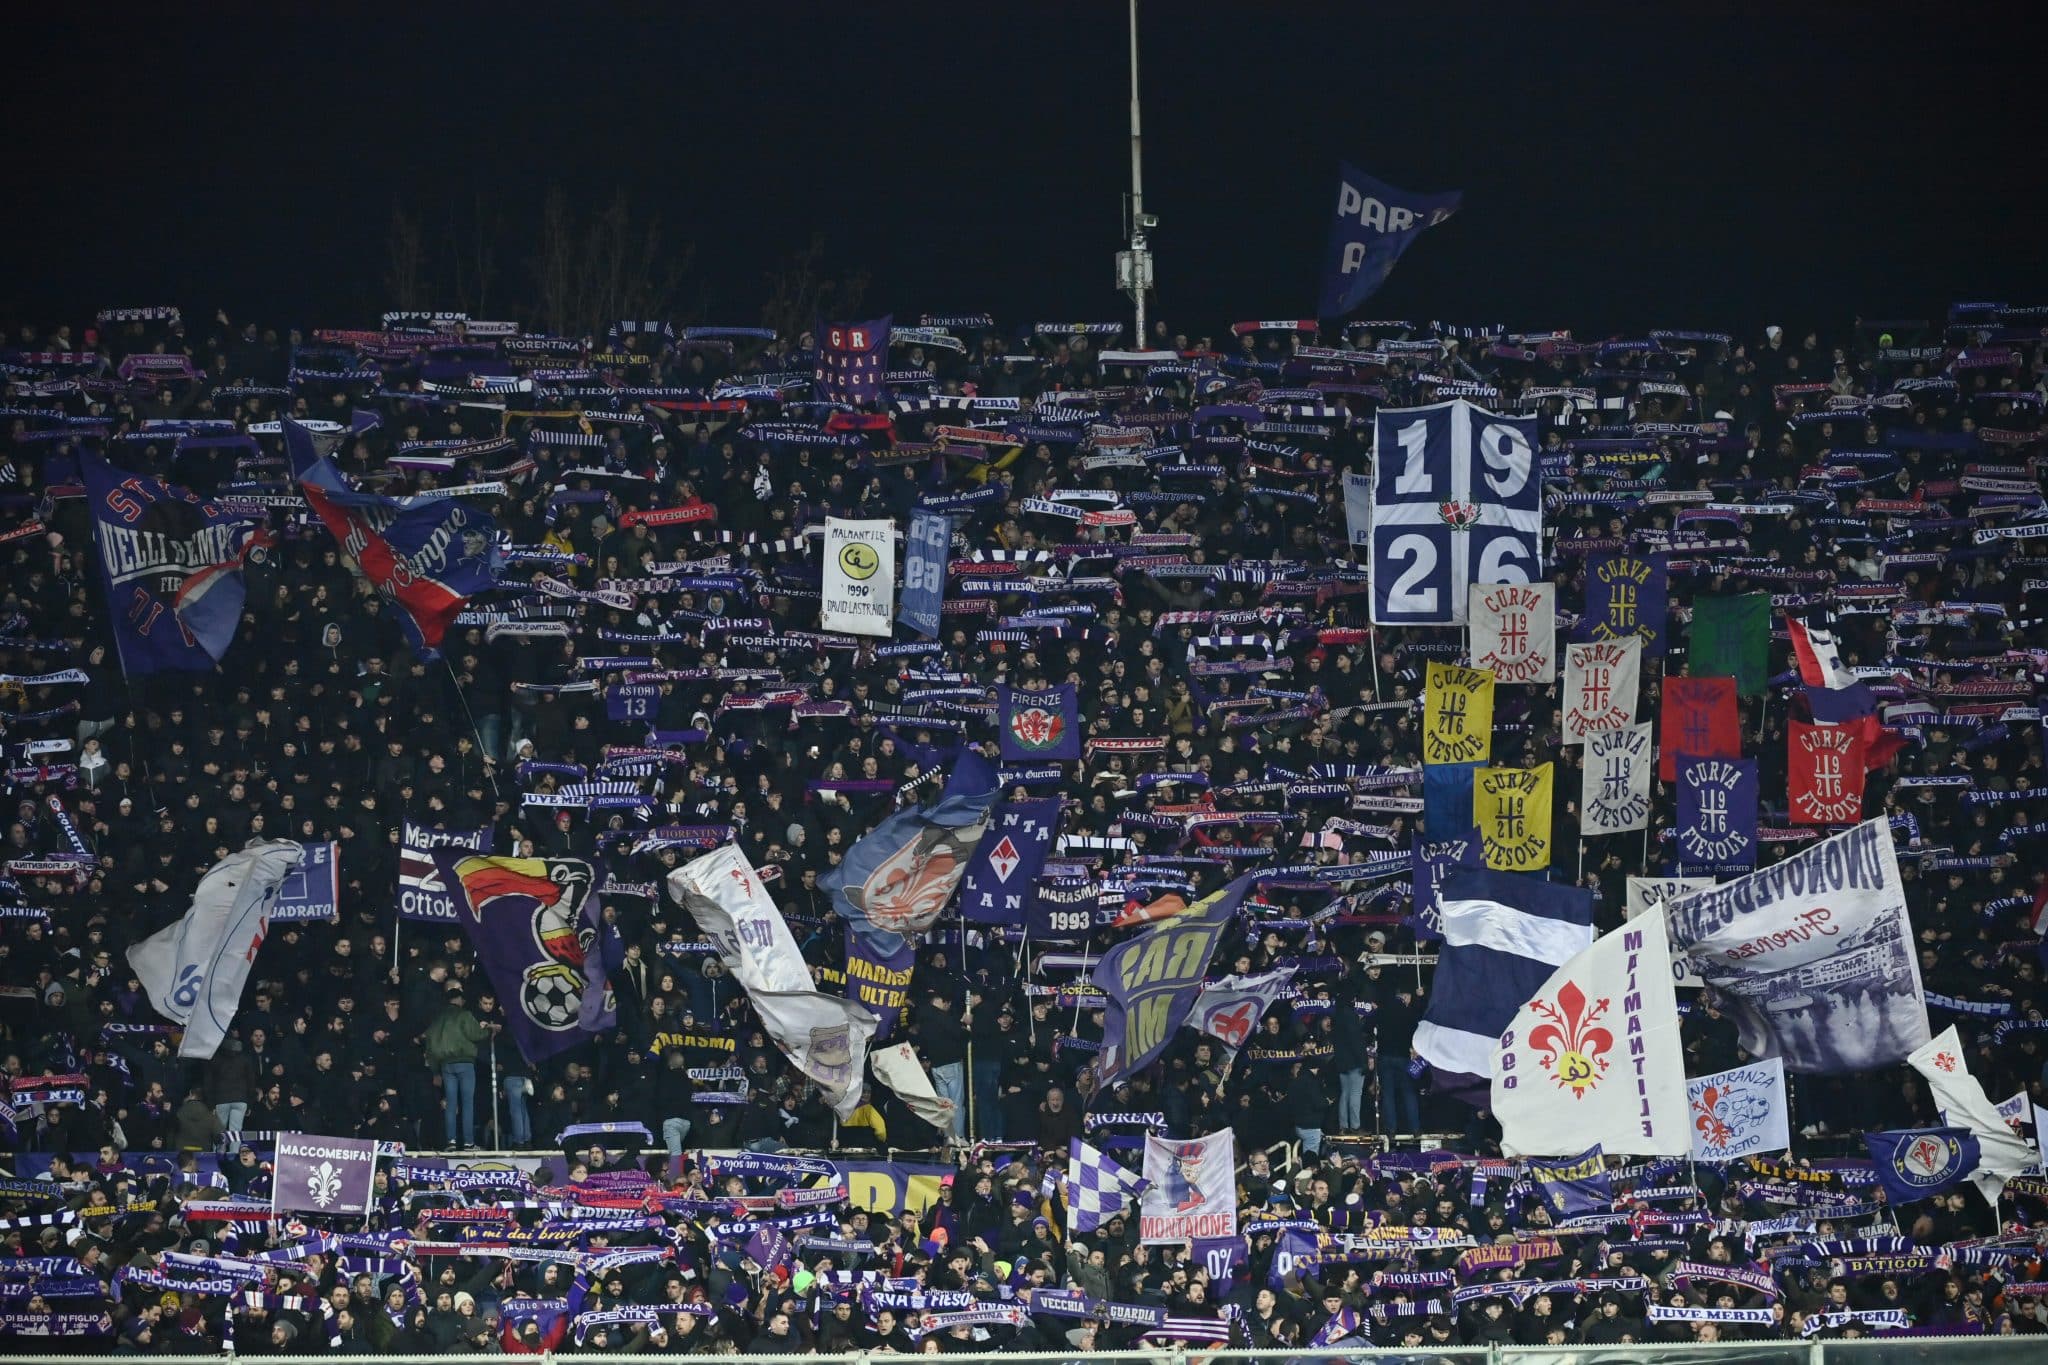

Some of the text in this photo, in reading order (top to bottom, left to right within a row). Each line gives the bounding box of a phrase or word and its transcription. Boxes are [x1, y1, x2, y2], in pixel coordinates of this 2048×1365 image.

[927, 316, 988, 326] FIORENTINA
[505, 341, 579, 351] FIORENTINA
[1609, 341, 1649, 351] FIORENTINA
[1419, 372, 1443, 384] AMICI
[618, 387, 691, 396] FIORENTINA
[1436, 386, 1498, 396] COLLETTIVO
[766, 432, 838, 444] FIORENTINA
[1027, 427, 1072, 438] FIORENTINA
[1977, 464, 2026, 473] FIORENTINA
[227, 496, 304, 507] FIORENTINA
[1819, 518, 1836, 526] ARE
[832, 527, 886, 543] MALMANTILE
[1978, 529, 2003, 540] JUVE
[511, 550, 575, 560] FIORENTINA
[1597, 557, 1652, 585] CURVA
[691, 578, 733, 587] FIORENTINA
[962, 581, 990, 593] CURVA
[847, 585, 869, 596] 1990
[1485, 587, 1538, 613] CURVA
[1039, 604, 1093, 616] FIORENTINA
[615, 632, 682, 641] FIORENTINA
[732, 635, 813, 648] FIORENTINA
[877, 642, 942, 657] ACF FIORENTINA
[606, 658, 649, 667] Fiorentina
[1572, 645, 1627, 669] CURVA
[1478, 650, 1546, 681] FIESOLE
[1432, 670, 1482, 693] CURVA
[618, 685, 655, 696] ASTORI
[1011, 692, 1062, 706] FIRENZE
[624, 698, 646, 716] 13
[897, 716, 947, 726] FIORENTINA
[1427, 729, 1484, 761] FIESOLE
[1591, 731, 1643, 757] CURVA
[1800, 730, 1854, 754] CURVA
[1025, 769, 1061, 780] Guerriero
[1685, 760, 1742, 790] CURVA
[1483, 771, 1540, 794] CURVA
[598, 797, 641, 805] FIORENTINA
[1796, 791, 1862, 821] FIESOLE
[1587, 793, 1649, 828] FIESOLE
[659, 828, 725, 839] FIORENTINA
[1680, 825, 1749, 861] FIESOLE
[1482, 835, 1545, 868] FIESOLE
[1938, 857, 1990, 866] FORZA VIOLA
[1133, 868, 1185, 877] FIORENTINA
[1039, 886, 1101, 904] MARASMA
[1049, 911, 1090, 930] 1993
[673, 942, 692, 951] ACF
[1701, 1135, 1761, 1158] POGGETTO
[1913, 1166, 1954, 1185] TENSIONE
[794, 1187, 838, 1201] FIORENTINA
[1754, 1182, 1845, 1200] DI BABBO IN FIGLIO
[433, 1208, 508, 1220] FIORENTINA
[1643, 1212, 1702, 1221] FIORENTINA
[1140, 1212, 1232, 1240] MONTAIONE
[1264, 1220, 1319, 1230] FIORENTINA
[462, 1225, 534, 1240] Tu mi dai
[333, 1233, 385, 1247] Fiorentina
[1463, 1246, 1513, 1270] FIRENZE
[1851, 1257, 1929, 1272] BATIGOL
[127, 1266, 232, 1293] AFICIONADOS
[1040, 1296, 1156, 1323] VECCHIA GUARDIA
[1653, 1307, 1772, 1323] JUVE MERDA
[6, 1314, 99, 1322] DI BABBO IN FIGLIO
[581, 1311, 658, 1323] FIORENTINA
[940, 1310, 1004, 1323] FIORENTINA
[1853, 1309, 1909, 1328] MERDA
